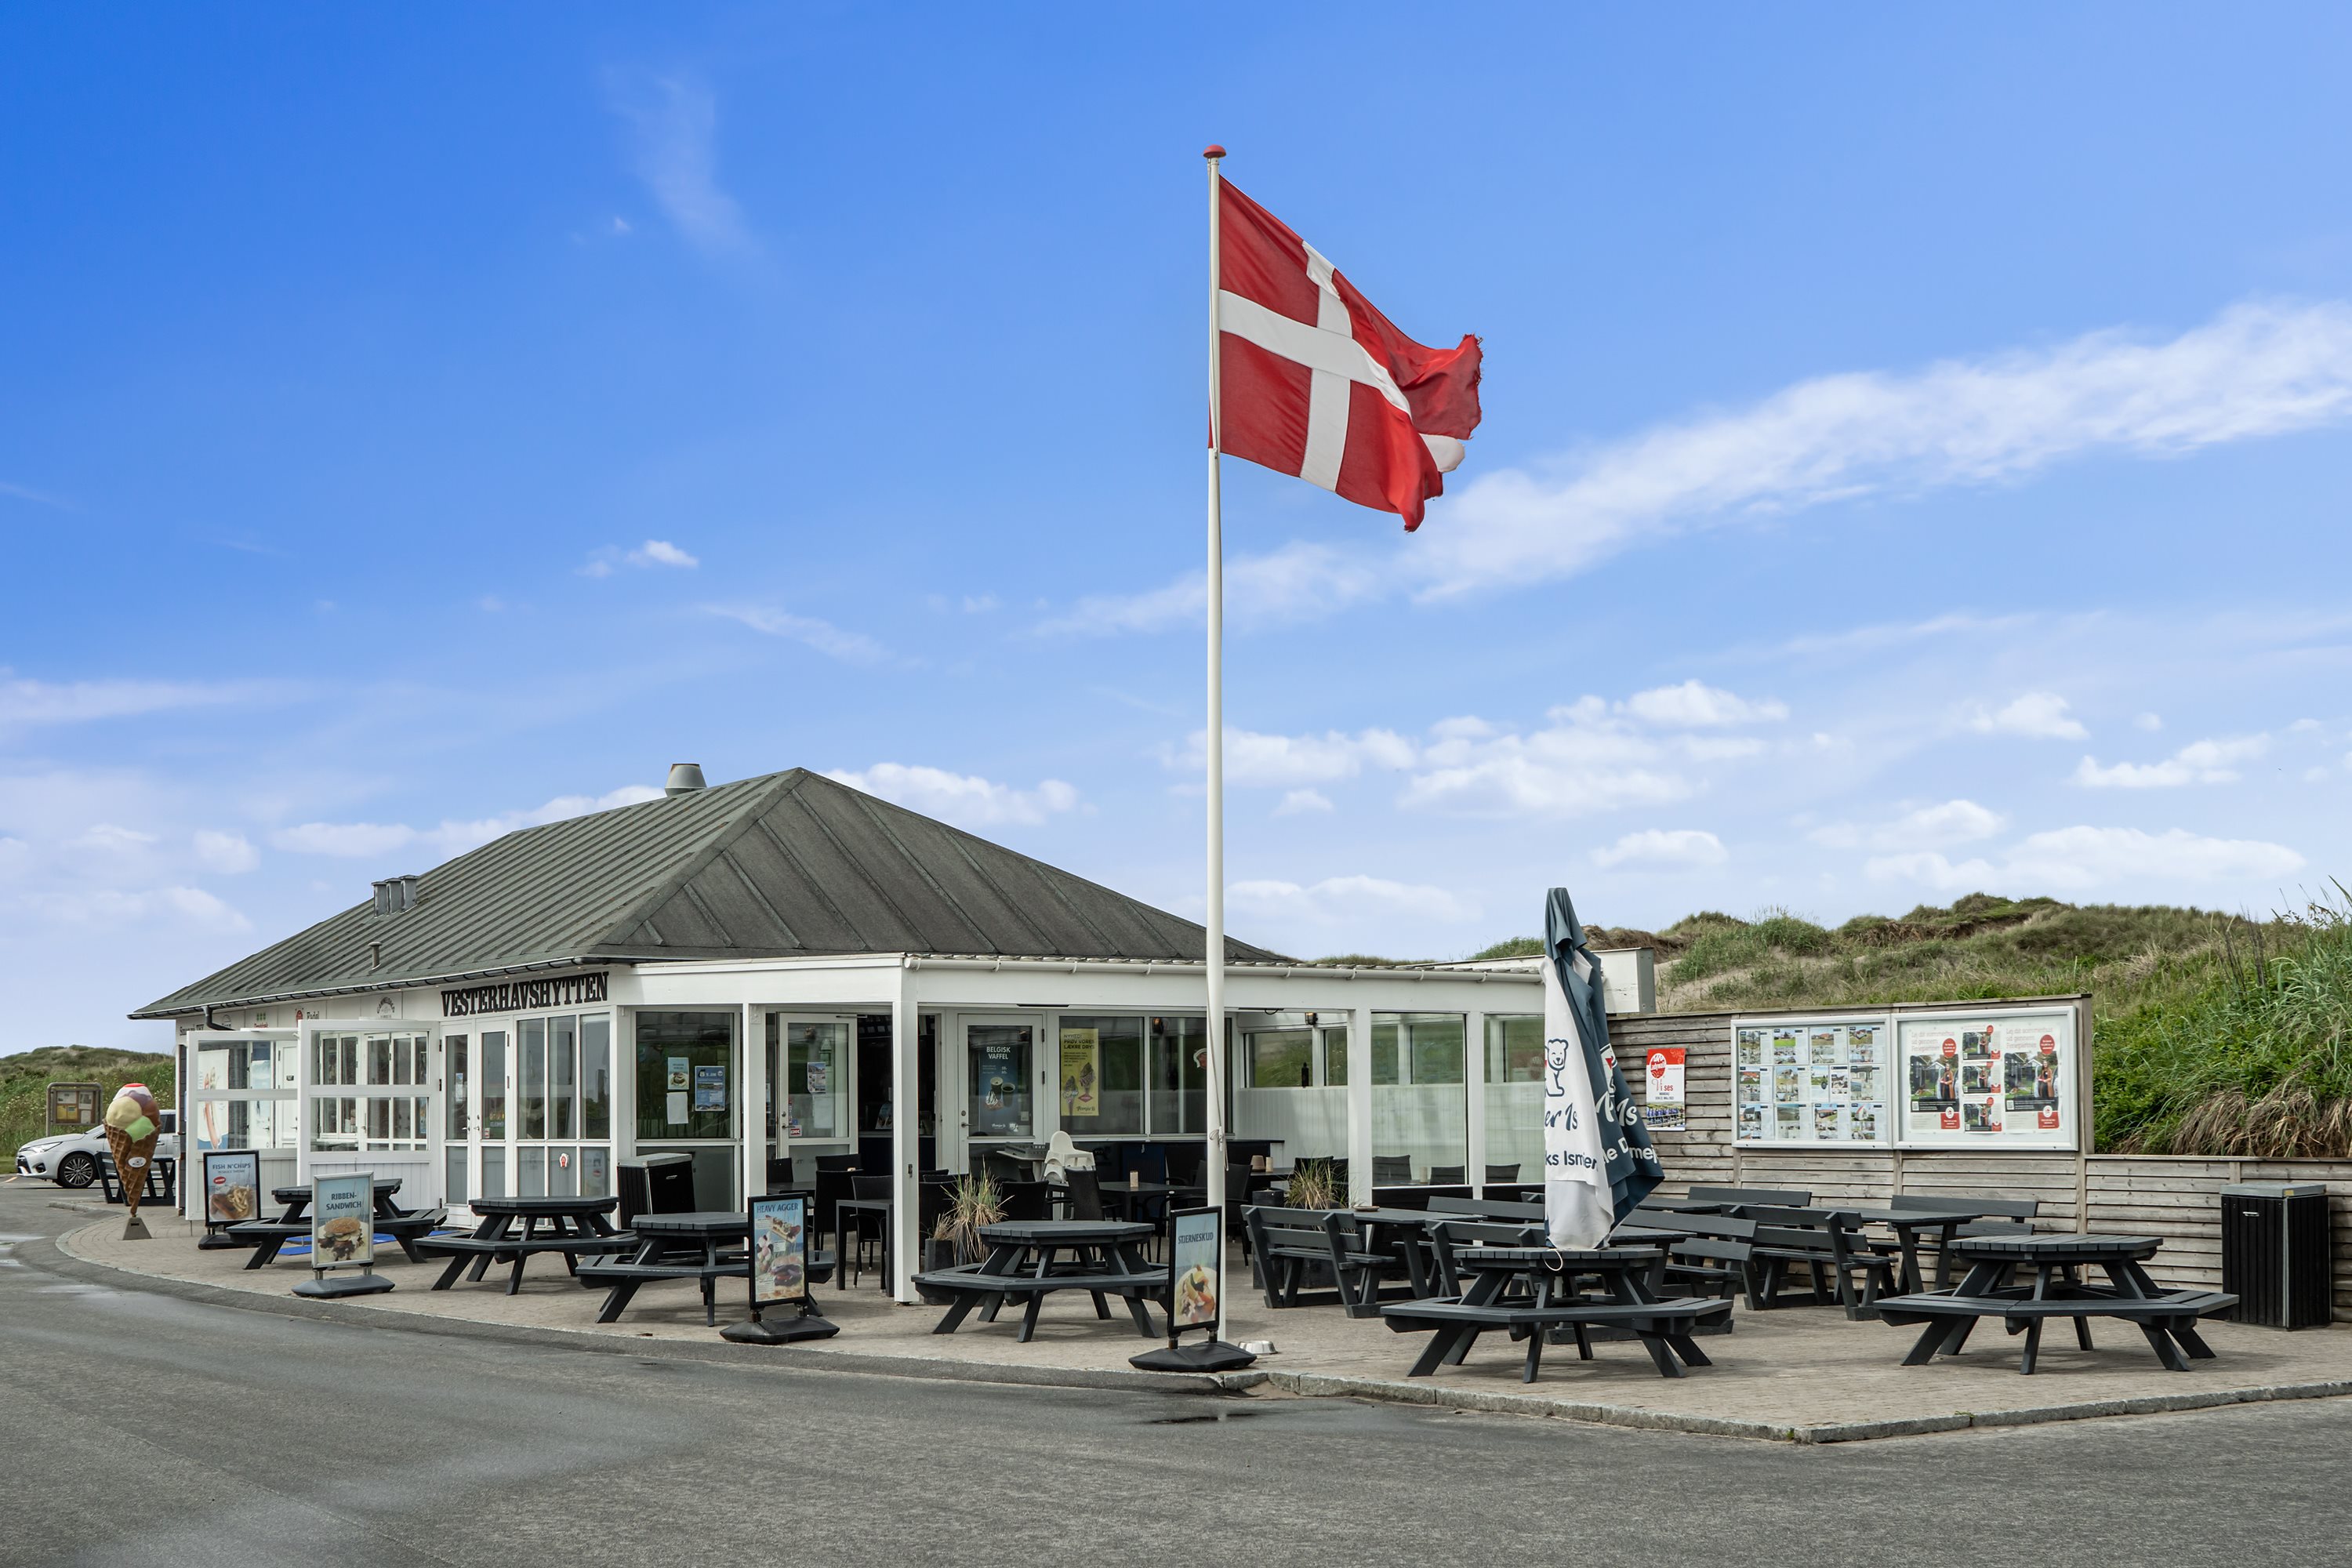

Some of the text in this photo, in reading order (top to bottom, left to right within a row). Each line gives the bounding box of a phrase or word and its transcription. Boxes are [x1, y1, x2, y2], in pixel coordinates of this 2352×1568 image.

[441, 971, 609, 1017] VESTERHAVSHYTTEN
[1565, 1102, 1578, 1131] Is
[331, 1192, 358, 1200] RIBBEN-
[326, 1201, 362, 1210] SANDWICH
[757, 1203, 799, 1213] HEAVY AGGER
[1178, 1232, 1214, 1244] STJERNESKUD
